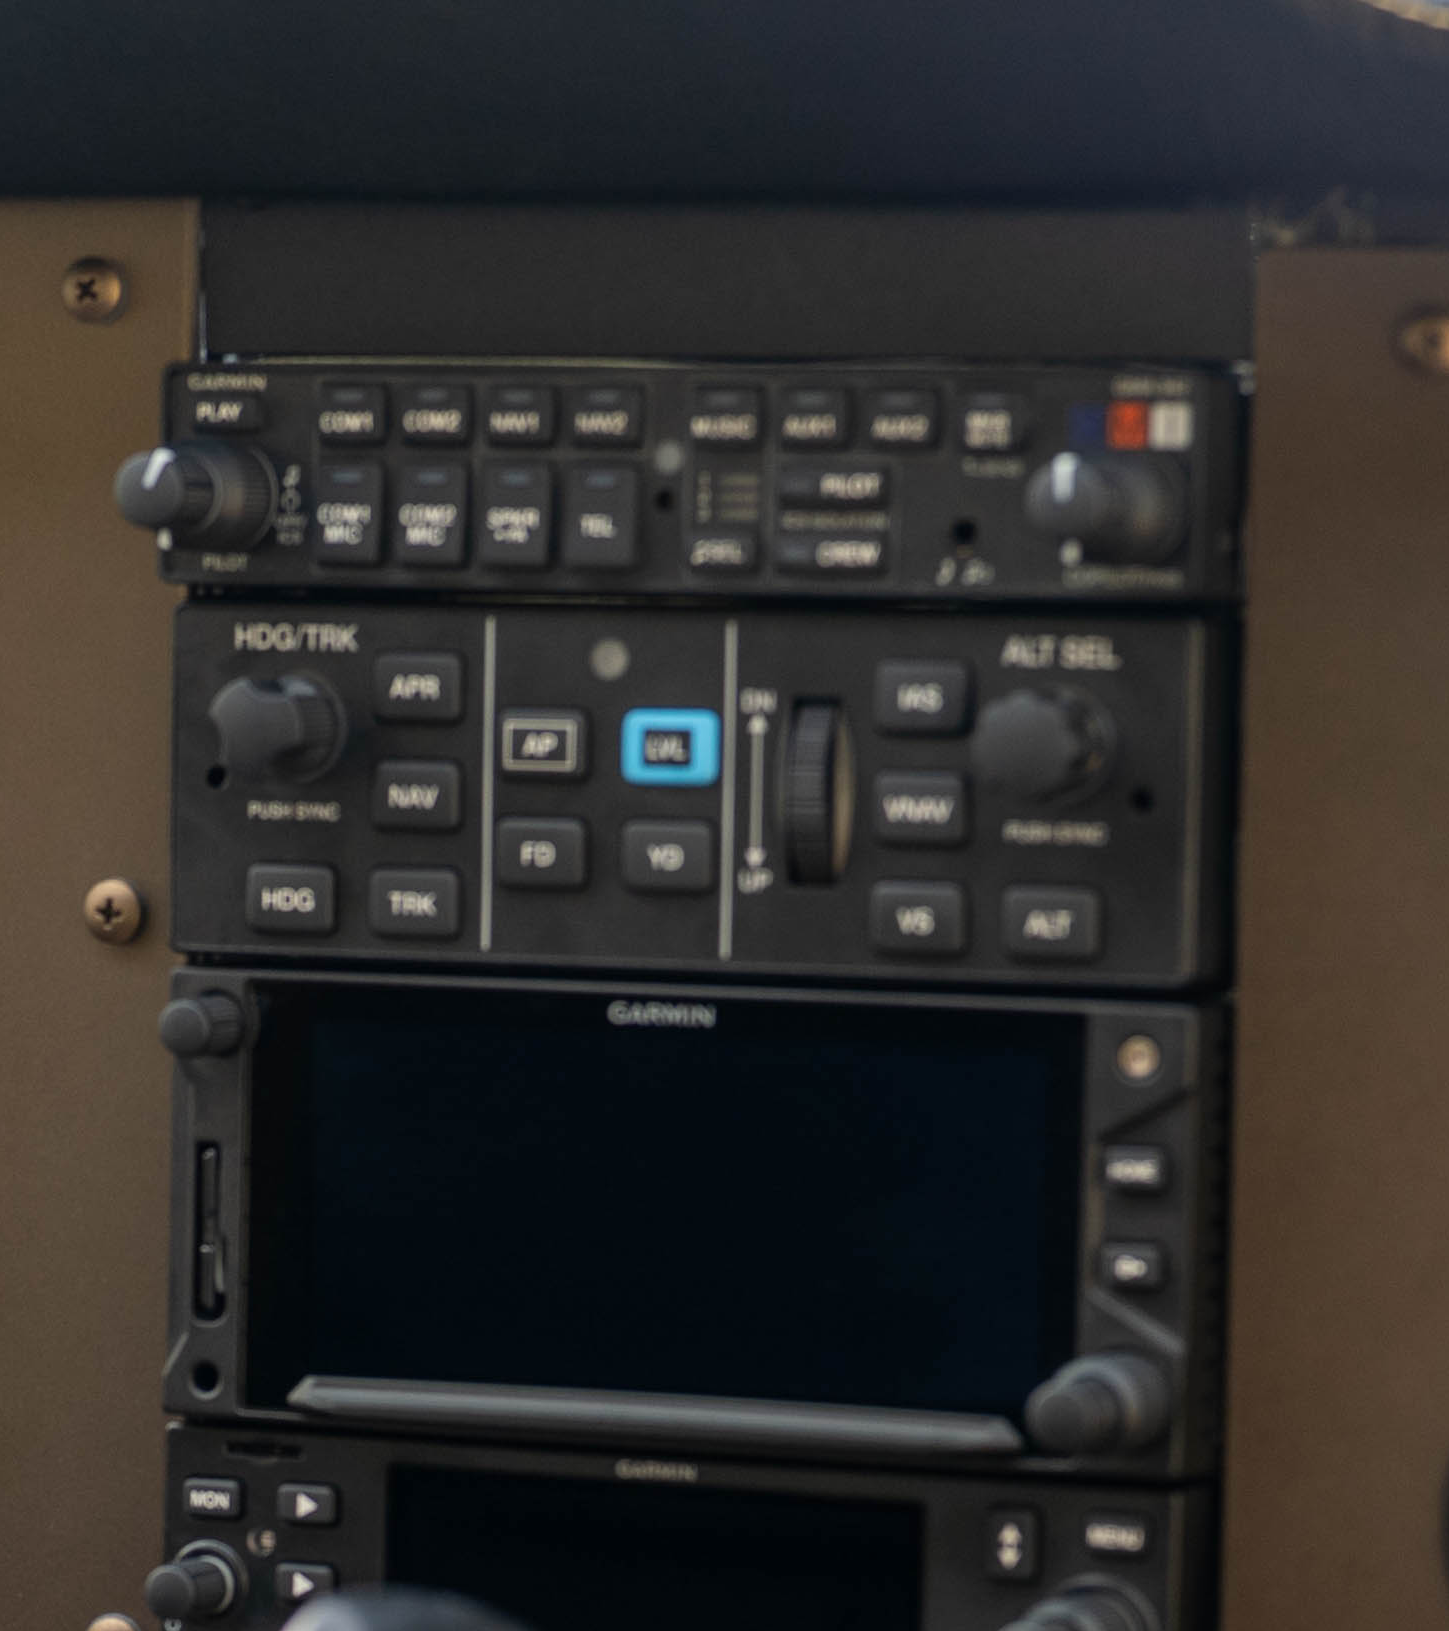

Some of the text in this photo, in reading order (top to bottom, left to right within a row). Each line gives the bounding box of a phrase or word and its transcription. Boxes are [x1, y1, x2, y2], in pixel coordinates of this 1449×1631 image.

[196, 402, 243, 422] PLAY
[235, 623, 359, 653] HDG/TRK
[1001, 634, 1055, 669] ALT
[389, 674, 440, 700] APR
[388, 784, 439, 810] NAV
[261, 887, 315, 912] HDG
[388, 890, 437, 918] TRK
[607, 1000, 717, 1028] GARMIN
[190, 1490, 231, 1511] MON
